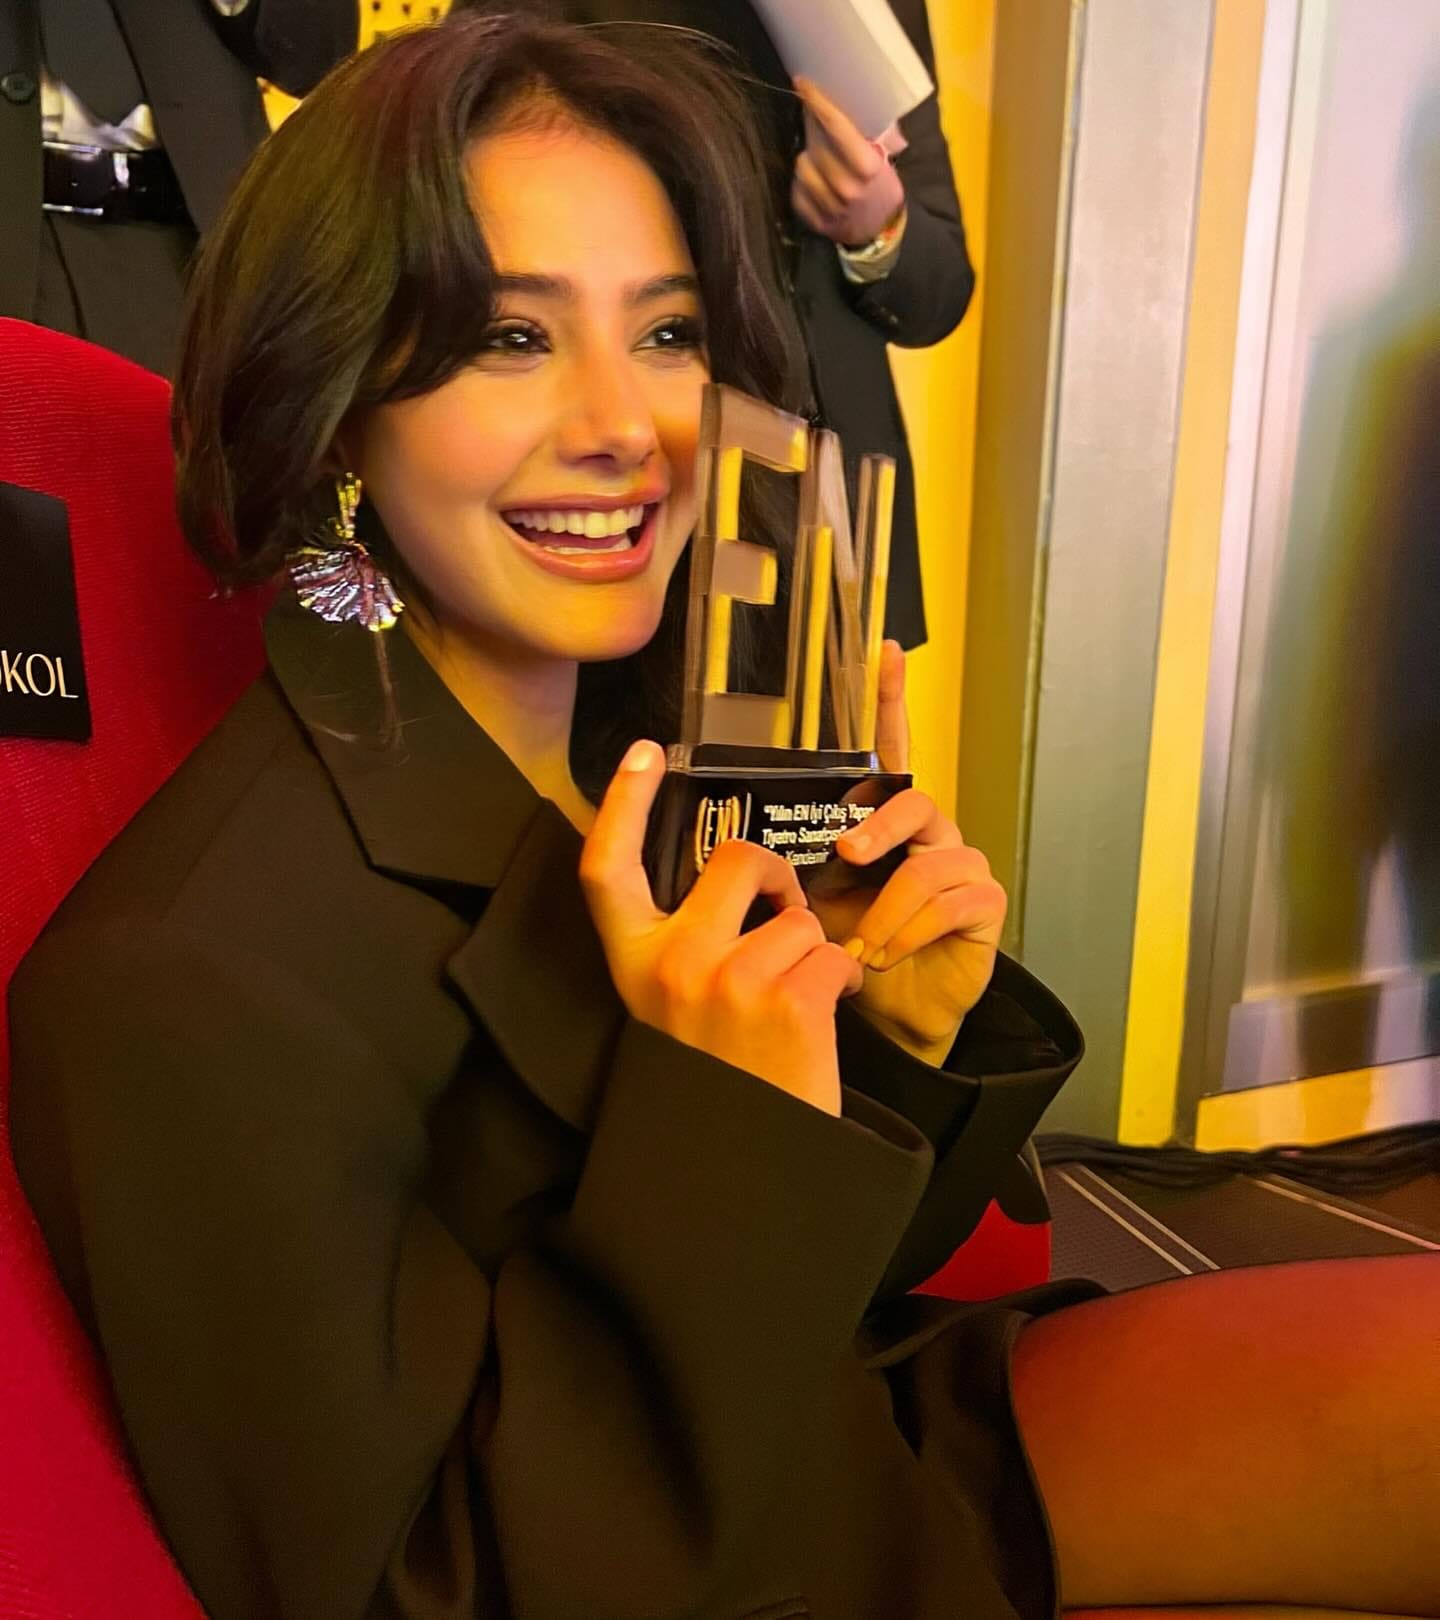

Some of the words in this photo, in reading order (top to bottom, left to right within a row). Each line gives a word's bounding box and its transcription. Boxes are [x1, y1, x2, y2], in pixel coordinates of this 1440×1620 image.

[683, 382, 895, 752] EN
[0, 650, 79, 698] KOL
[793, 804, 810, 821] EN
[762, 828, 798, 849] Tiyatro
